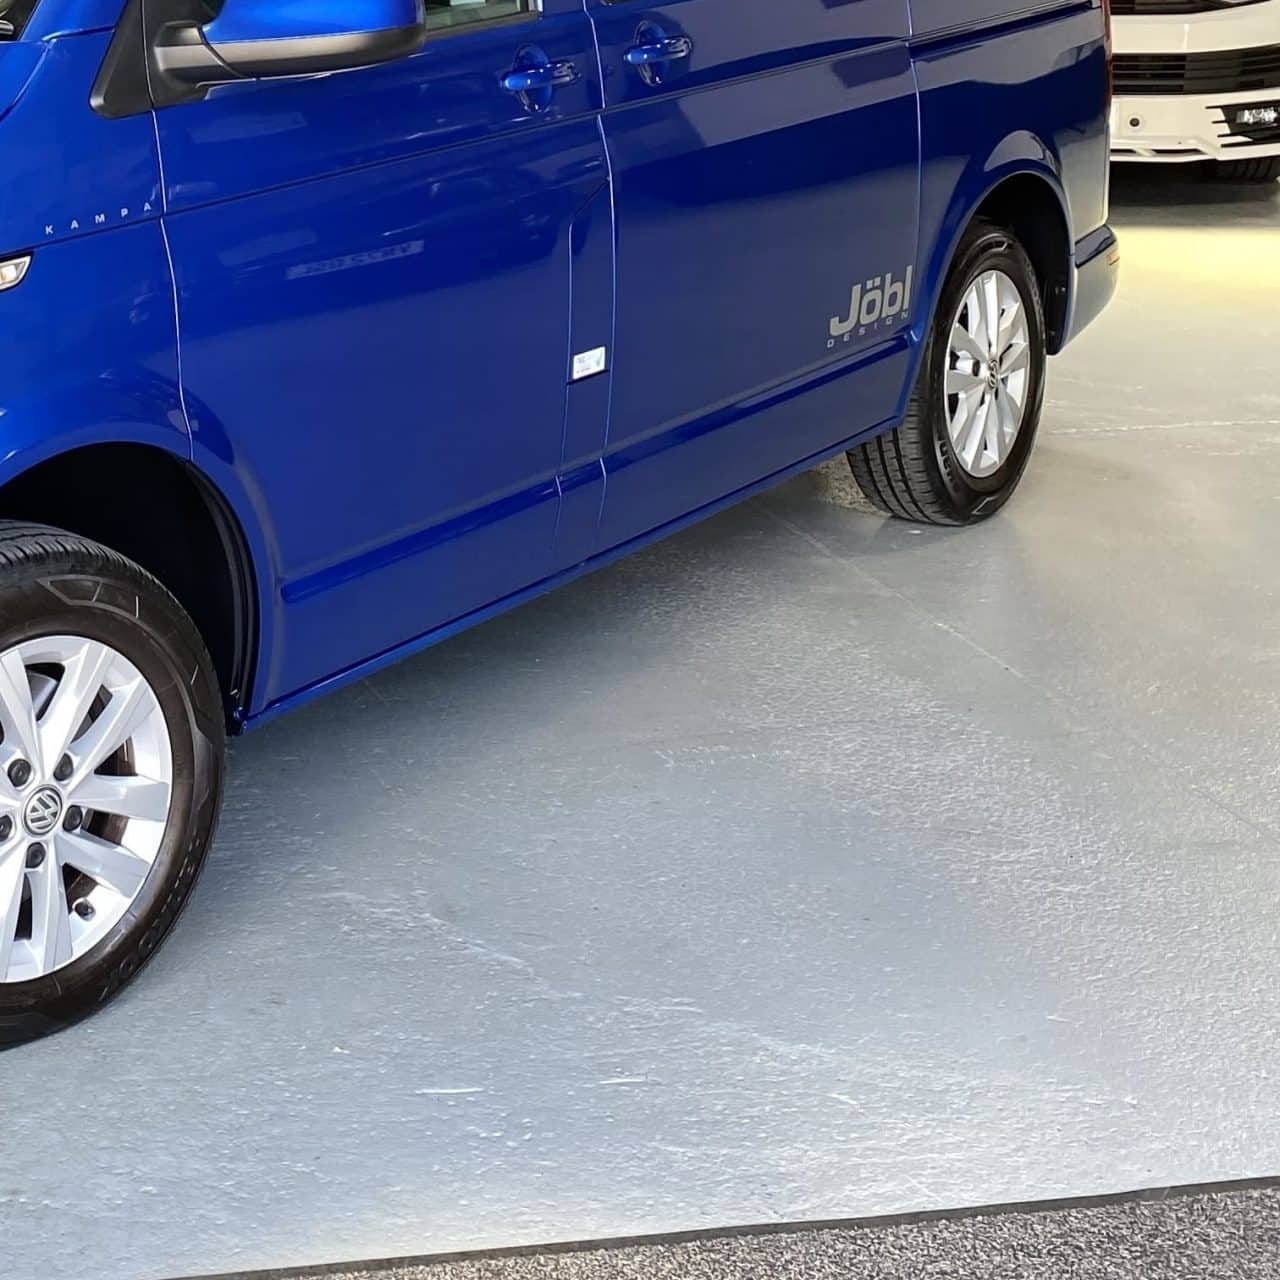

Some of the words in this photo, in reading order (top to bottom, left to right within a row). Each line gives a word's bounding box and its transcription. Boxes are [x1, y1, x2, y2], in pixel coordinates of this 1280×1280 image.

[45, 202, 152, 235] KAMPA
[829, 265, 913, 337] Jöbl
[826, 310, 910, 348] DESIGN
